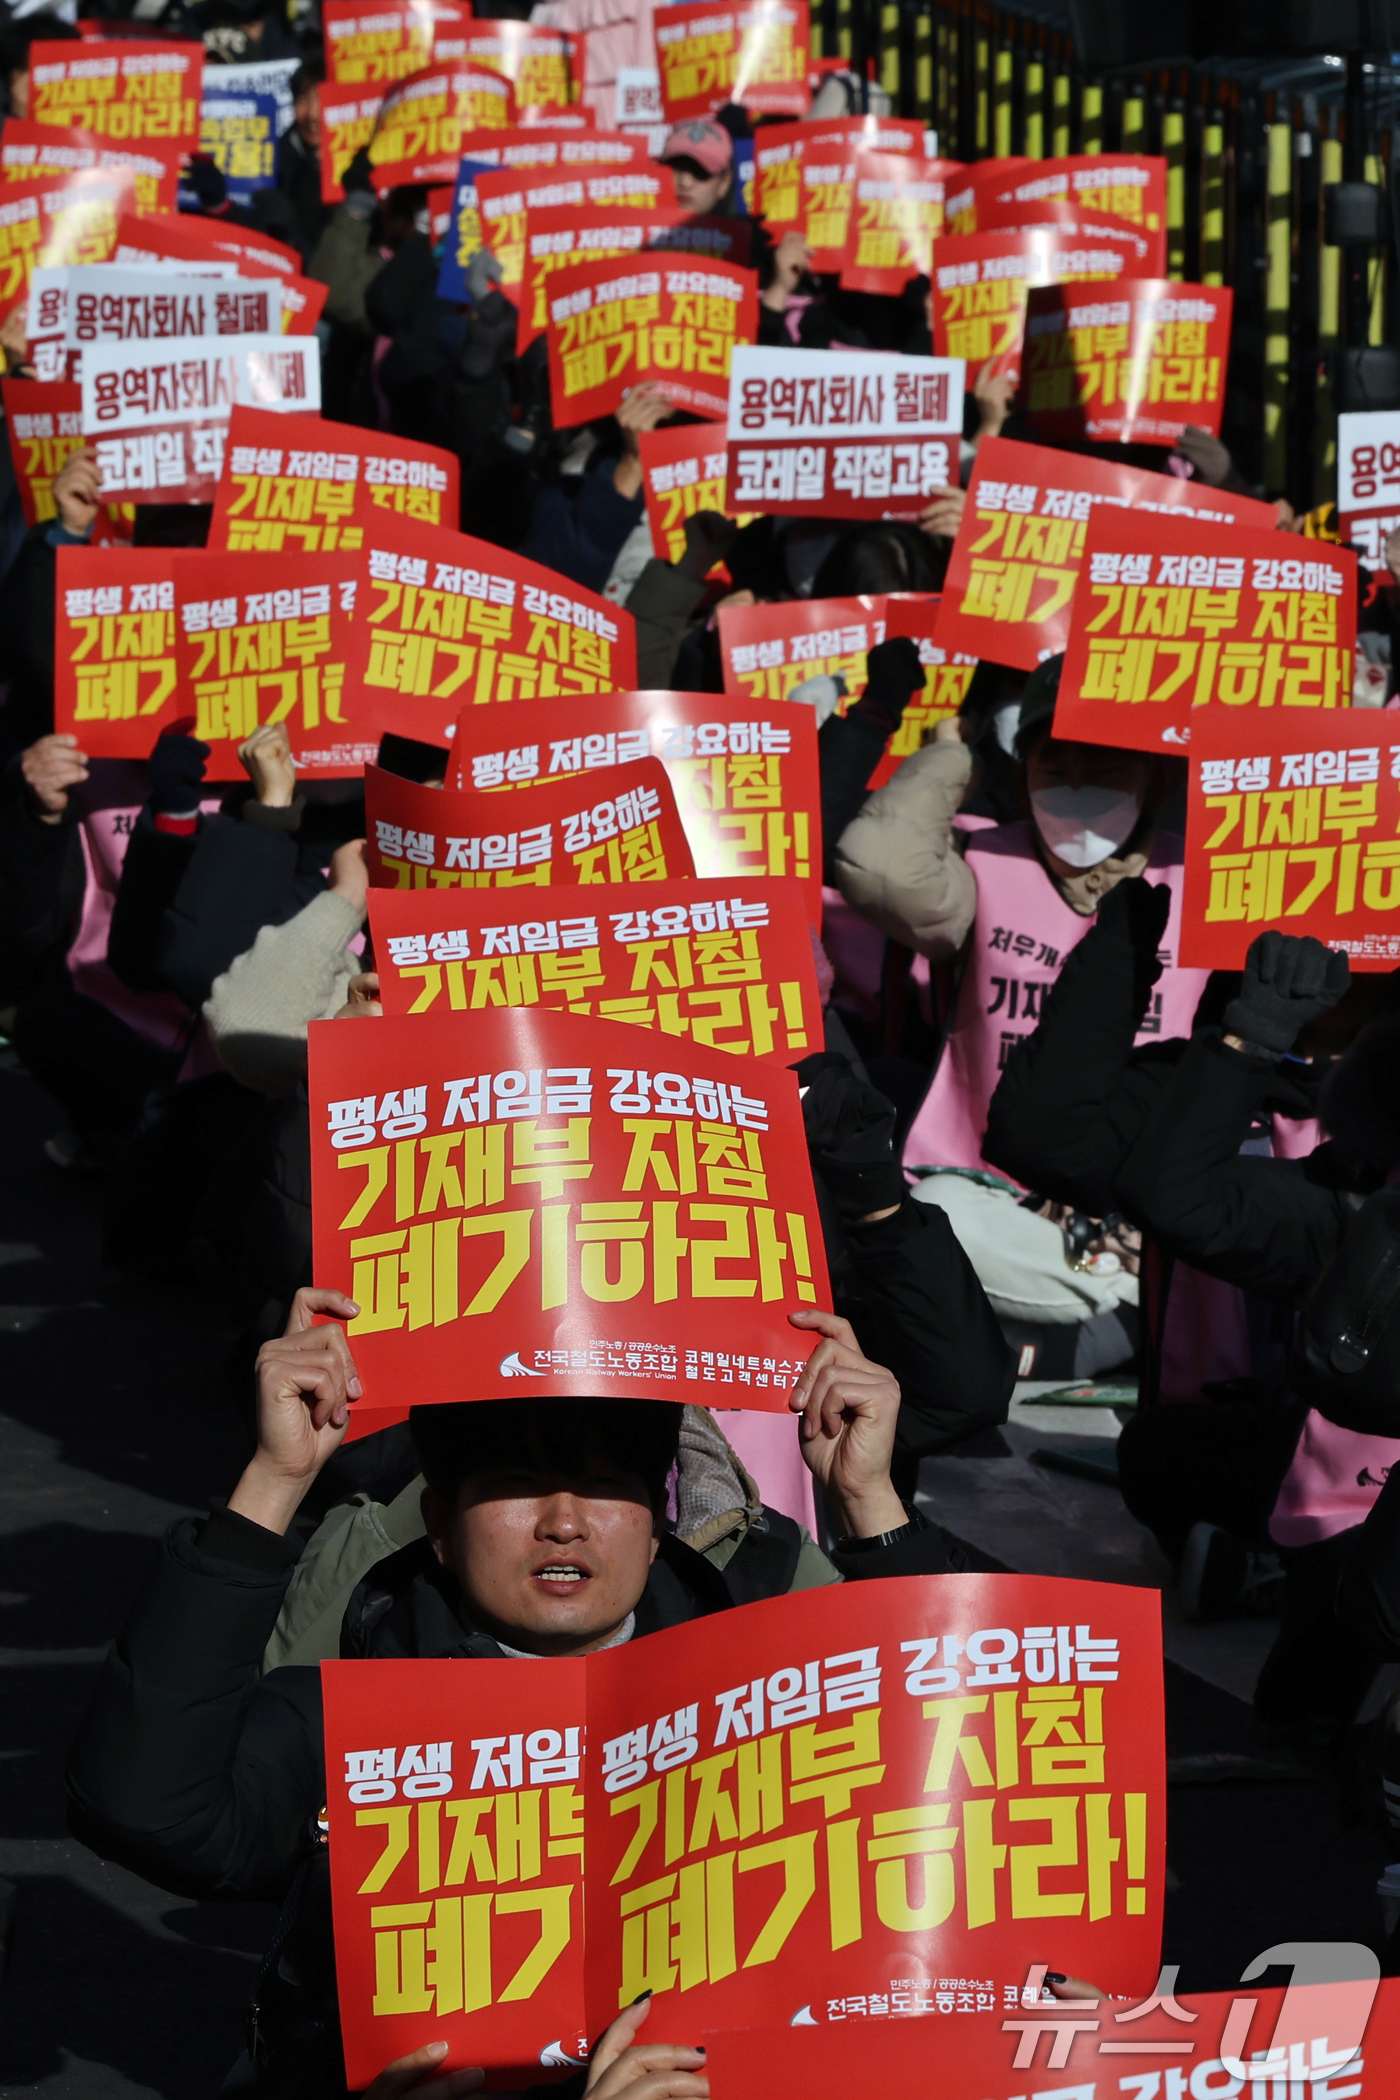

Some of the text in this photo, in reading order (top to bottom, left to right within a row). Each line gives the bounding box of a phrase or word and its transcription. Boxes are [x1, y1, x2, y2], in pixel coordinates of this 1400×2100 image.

[76, 293, 206, 340] 용역자회사
[551, 271, 743, 323] 평생 저임금 강요하는
[556, 293, 737, 354] 기재부 지침
[94, 355, 239, 420] 용역자회사
[740, 373, 885, 430] 용역자회사
[893, 371, 949, 425] 철폐
[96, 431, 187, 494] 코레일
[231, 447, 448, 491] 평생 저임금 강요하는
[650, 457, 699, 493] 평생
[734, 441, 949, 501] 코레일 직접고용
[226, 475, 356, 524] 기재부
[976, 480, 1038, 514] 평생
[65, 585, 123, 618] 평생
[368, 549, 618, 643] 평생 저임금 강요하는
[1090, 552, 1344, 595] 평생 저임금 강요하는
[181, 597, 238, 633] 평생
[245, 584, 331, 624] 저임금
[366, 579, 514, 647] 기재부
[525, 613, 611, 679] 지침
[1084, 585, 1337, 643] 기재부 지침
[187, 614, 332, 680] 기재부
[730, 640, 784, 674] 평생
[790, 624, 868, 661] 저임금
[1079, 638, 1350, 709] 폐기하라!
[472, 744, 539, 789] 평생
[549, 729, 650, 773] 저임금
[661, 721, 792, 759] 강요하는
[670, 754, 783, 811] 지침
[1200, 747, 1380, 794] 평생 저임금
[375, 784, 662, 871] 평생 저임금 강요하는
[1203, 782, 1379, 849] 기재부
[387, 898, 770, 967] 평생 저임금 강요하는
[399, 929, 763, 1015] 기재부 지침
[327, 1068, 768, 1149] 평생 저임금 강요하는
[337, 1117, 768, 1230] 기재부 지침
[347, 1200, 816, 1337] 폐기하라!
[534, 1350, 678, 1372] 전국철도노동조합
[553, 1368, 584, 1376] Korean
[585, 1368, 616, 1378] Railway
[654, 1372, 677, 1380] Union
[601, 1625, 1120, 1794] 평생 저임금 강요하는
[344, 1741, 453, 1804] 평생
[609, 1686, 1106, 1887] 기재부 지침
[618, 1792, 1147, 2010] 폐기하라!
[827, 1993, 996, 2021] 전국철도노동조합
[938, 1979, 994, 1991] 공공운수노조
